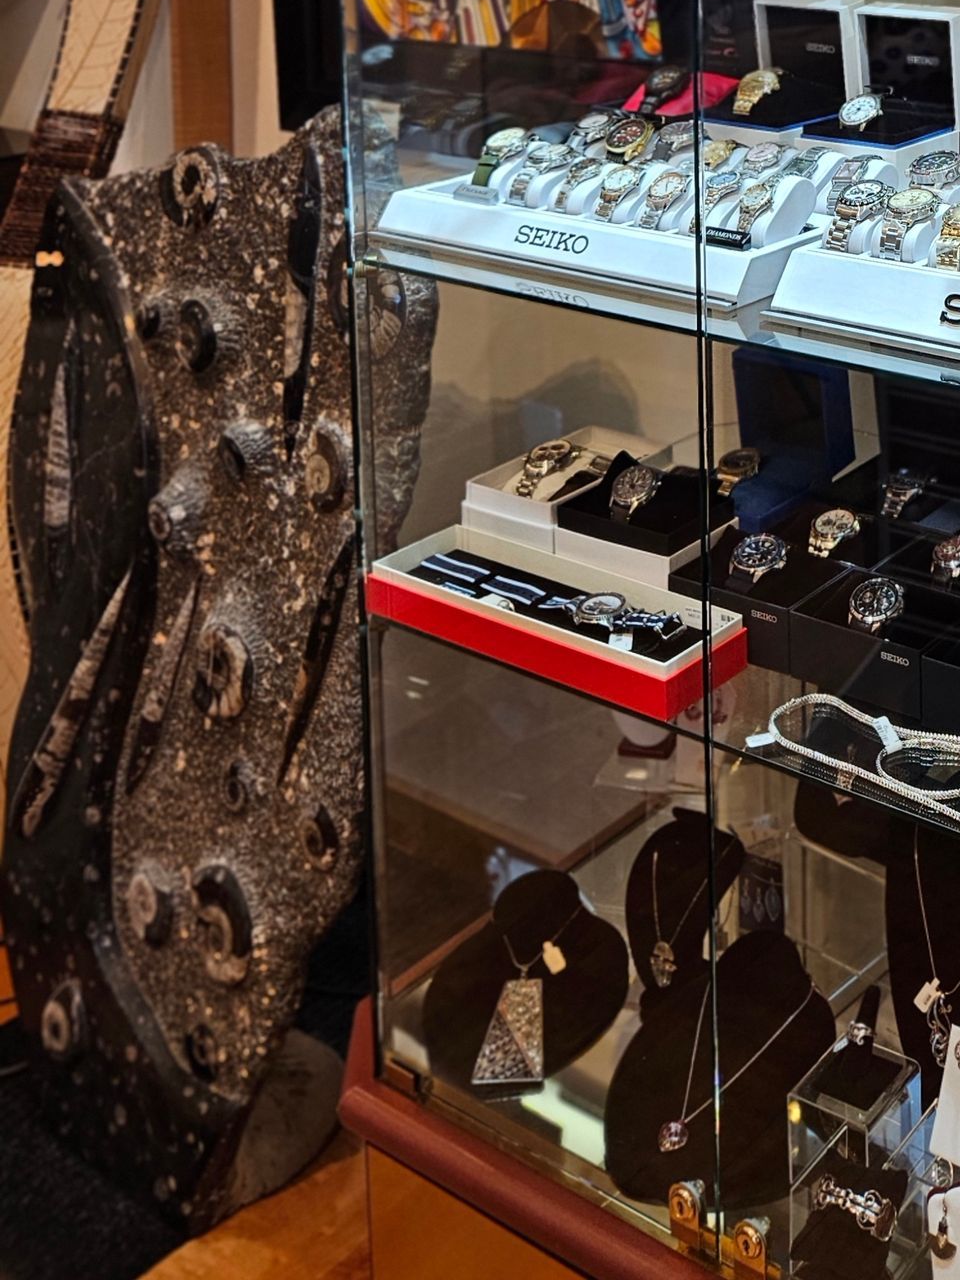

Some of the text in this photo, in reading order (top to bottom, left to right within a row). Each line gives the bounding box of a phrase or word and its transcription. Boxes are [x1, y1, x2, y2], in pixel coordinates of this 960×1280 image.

[514, 224, 589, 255] SEIKO
[750, 609, 778, 624] SEIKO
[880, 651, 910, 667] SEIKO
